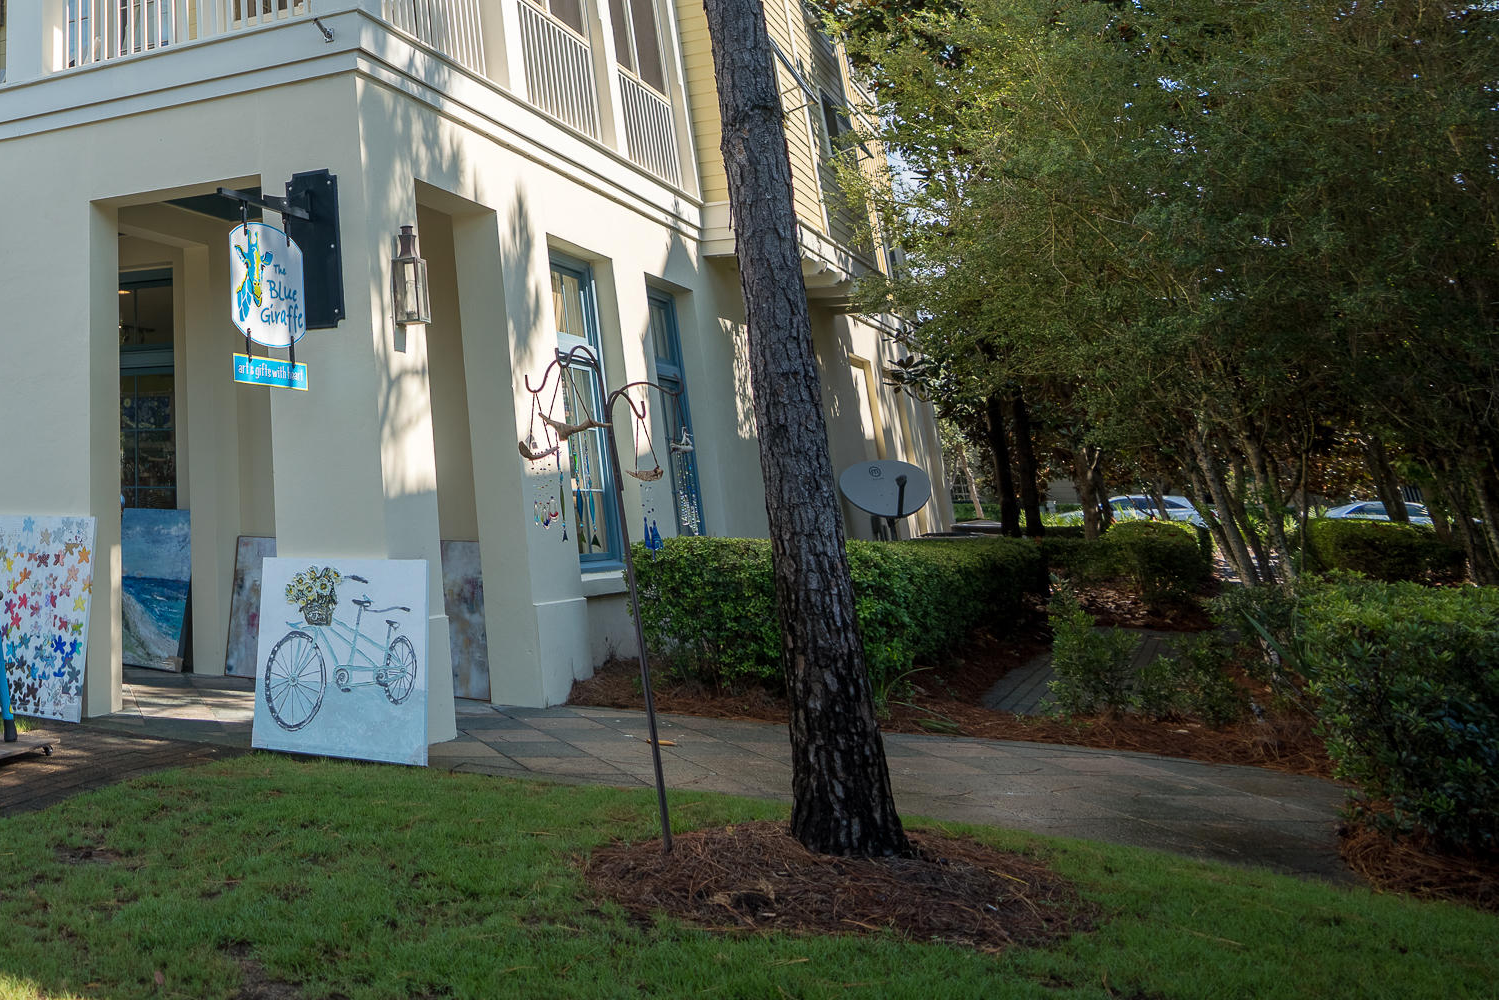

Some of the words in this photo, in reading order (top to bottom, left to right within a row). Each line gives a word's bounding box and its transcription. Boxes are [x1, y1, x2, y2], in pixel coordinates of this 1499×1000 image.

[273, 264, 286, 275] The
[260, 303, 303, 333] Giraffe
[238, 361, 249, 375] art
[255, 362, 271, 379] gifts
[272, 365, 286, 379] with
